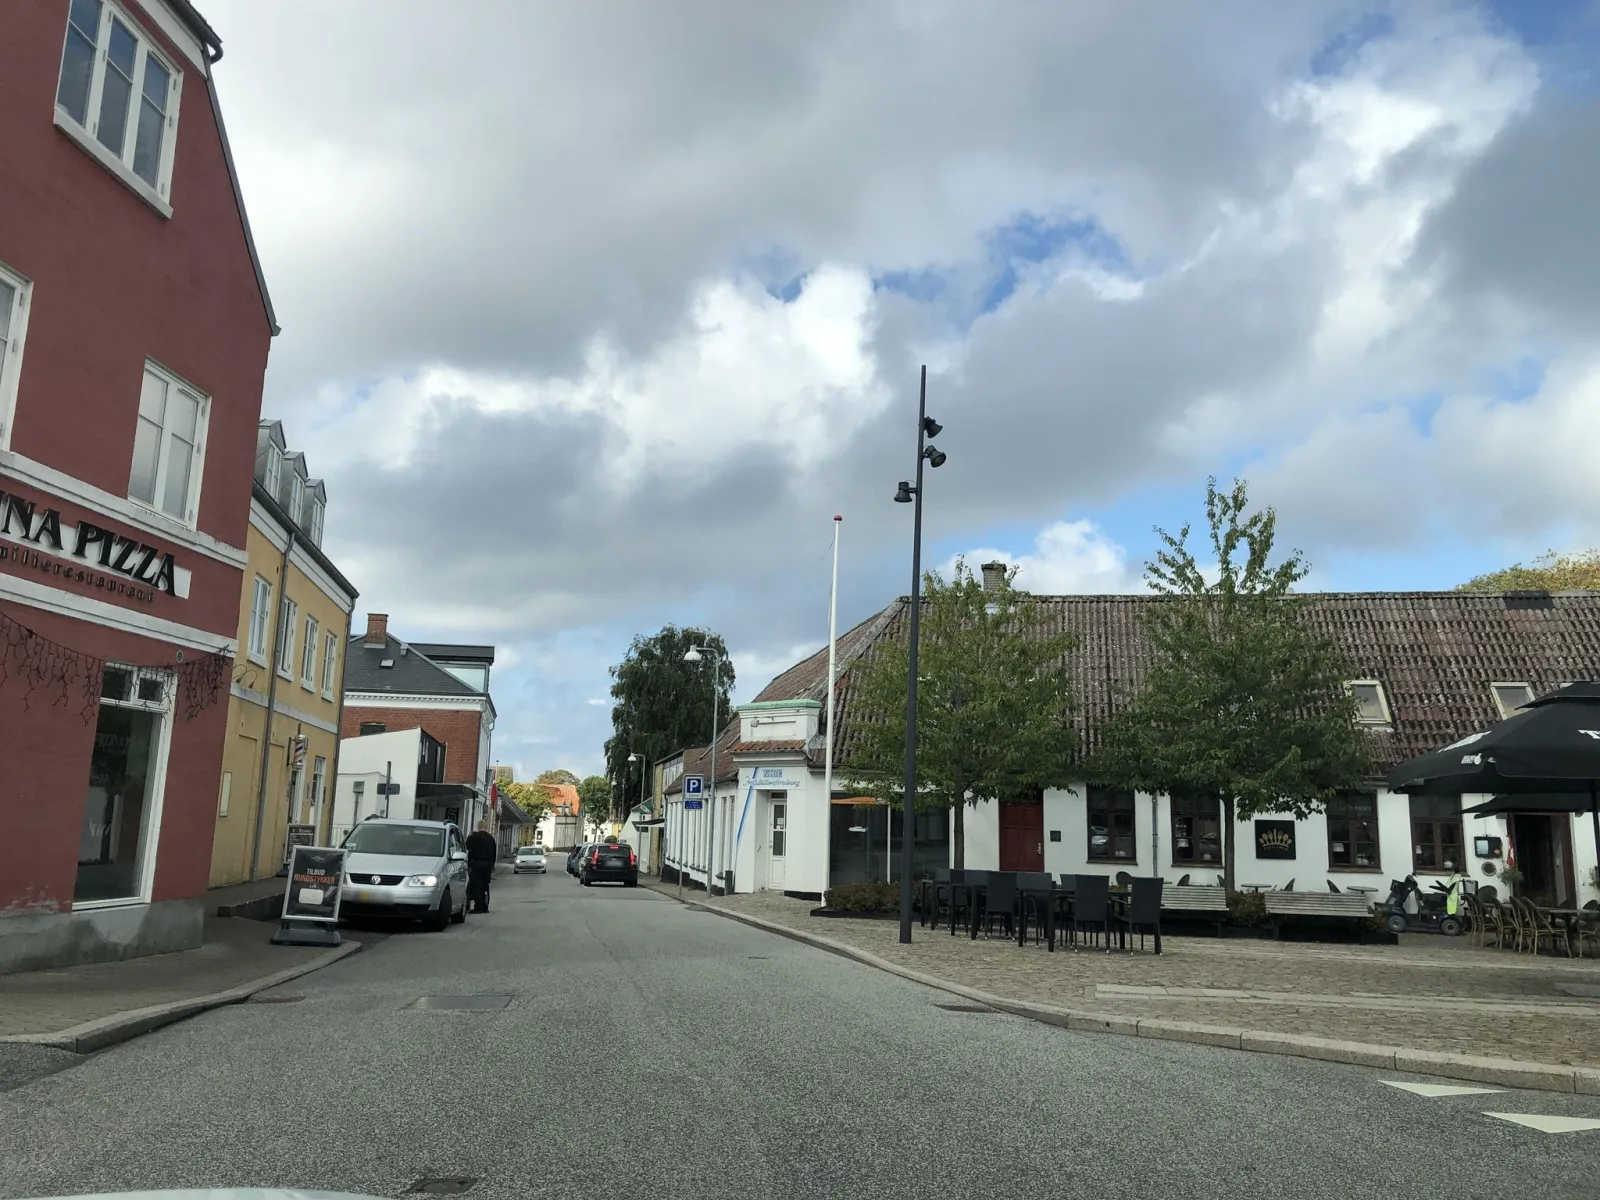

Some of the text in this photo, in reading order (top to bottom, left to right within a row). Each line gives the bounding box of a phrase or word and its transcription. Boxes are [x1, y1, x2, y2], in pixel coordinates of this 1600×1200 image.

[73, 519, 176, 597] PIZZA
[689, 779, 699, 792] P
[306, 867, 326, 876] TILBUD
[293, 873, 336, 884] RUNDSTYKKER
